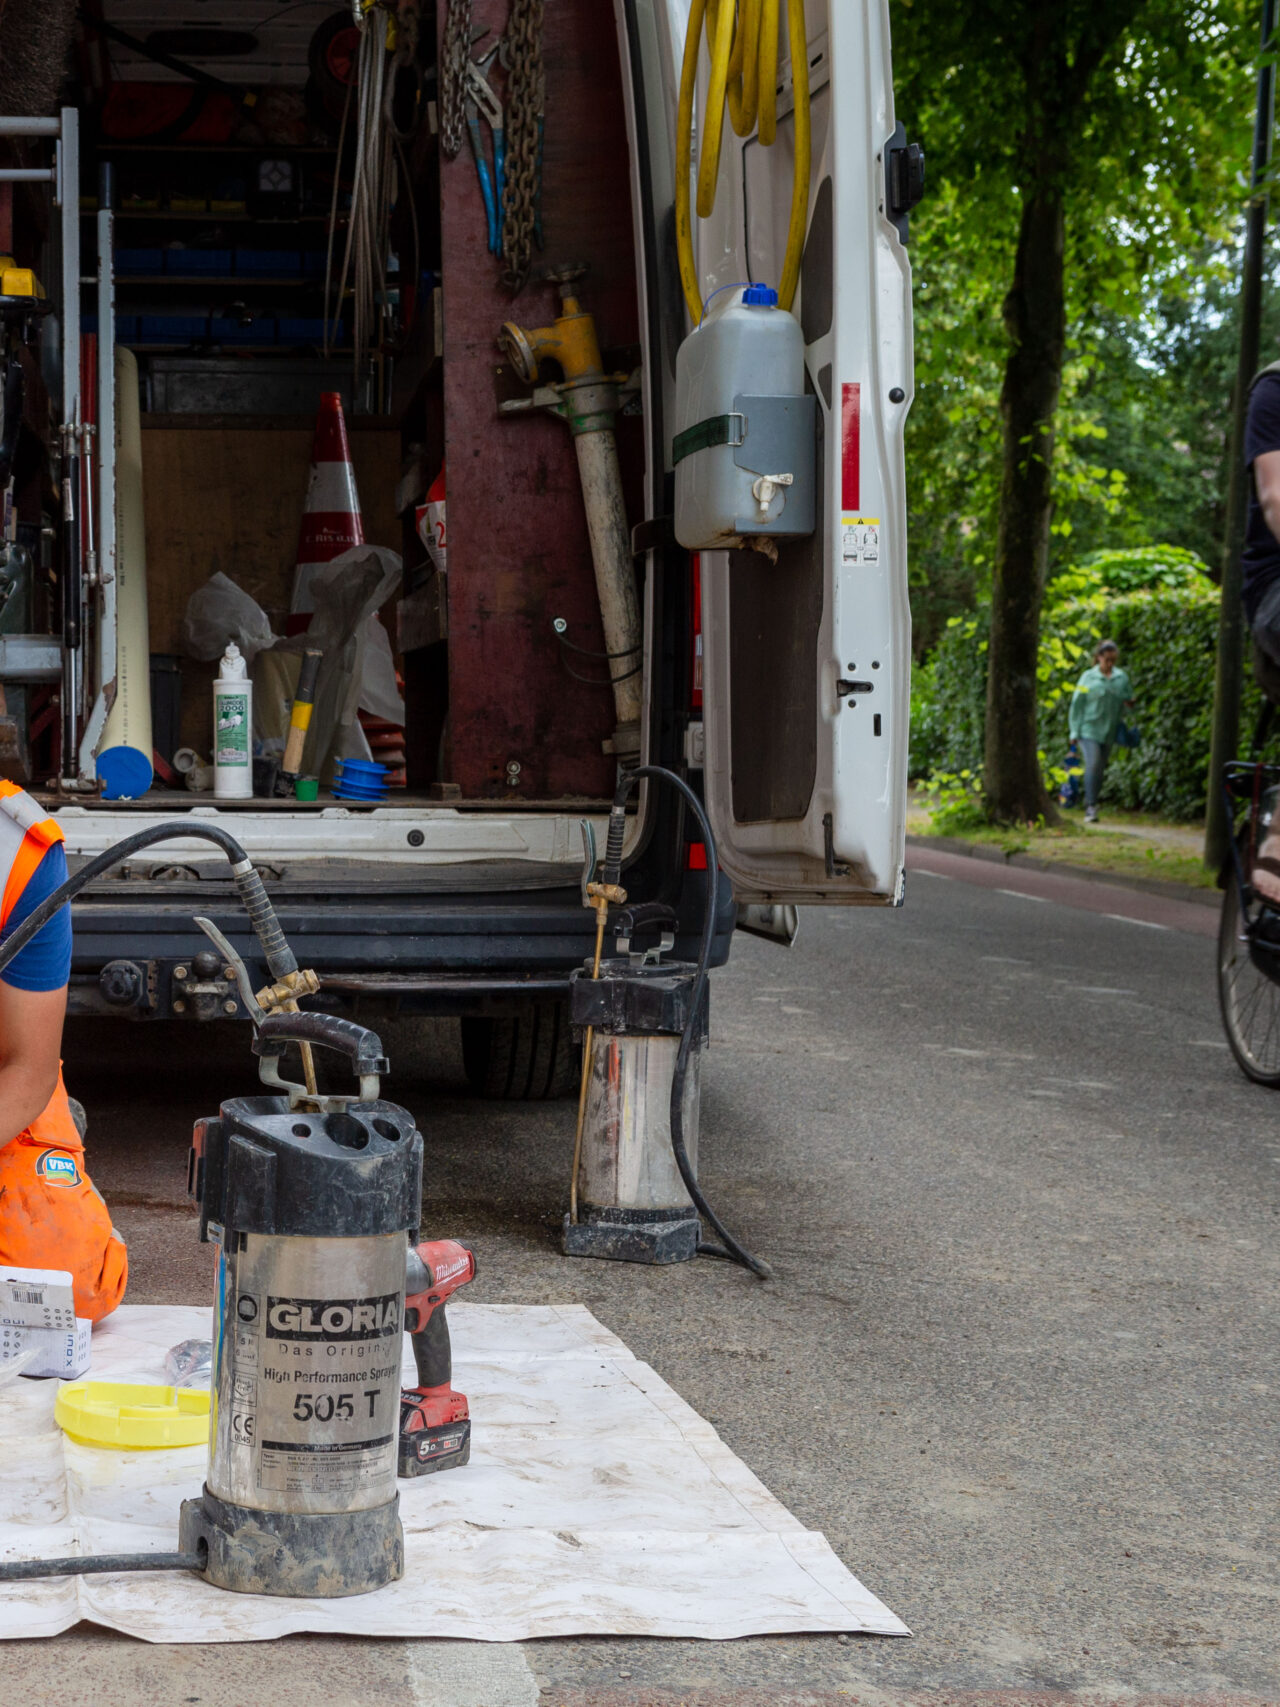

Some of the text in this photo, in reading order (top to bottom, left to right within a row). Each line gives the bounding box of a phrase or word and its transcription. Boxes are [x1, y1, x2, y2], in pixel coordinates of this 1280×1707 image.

[49, 1159, 74, 1170] VBK
[270, 1301, 399, 1334] GLORIA
[279, 1343, 393, 1357] Das Origin
[264, 1368, 290, 1383] High
[294, 1368, 367, 1383] Performance
[293, 1389, 381, 1422] 505 T
